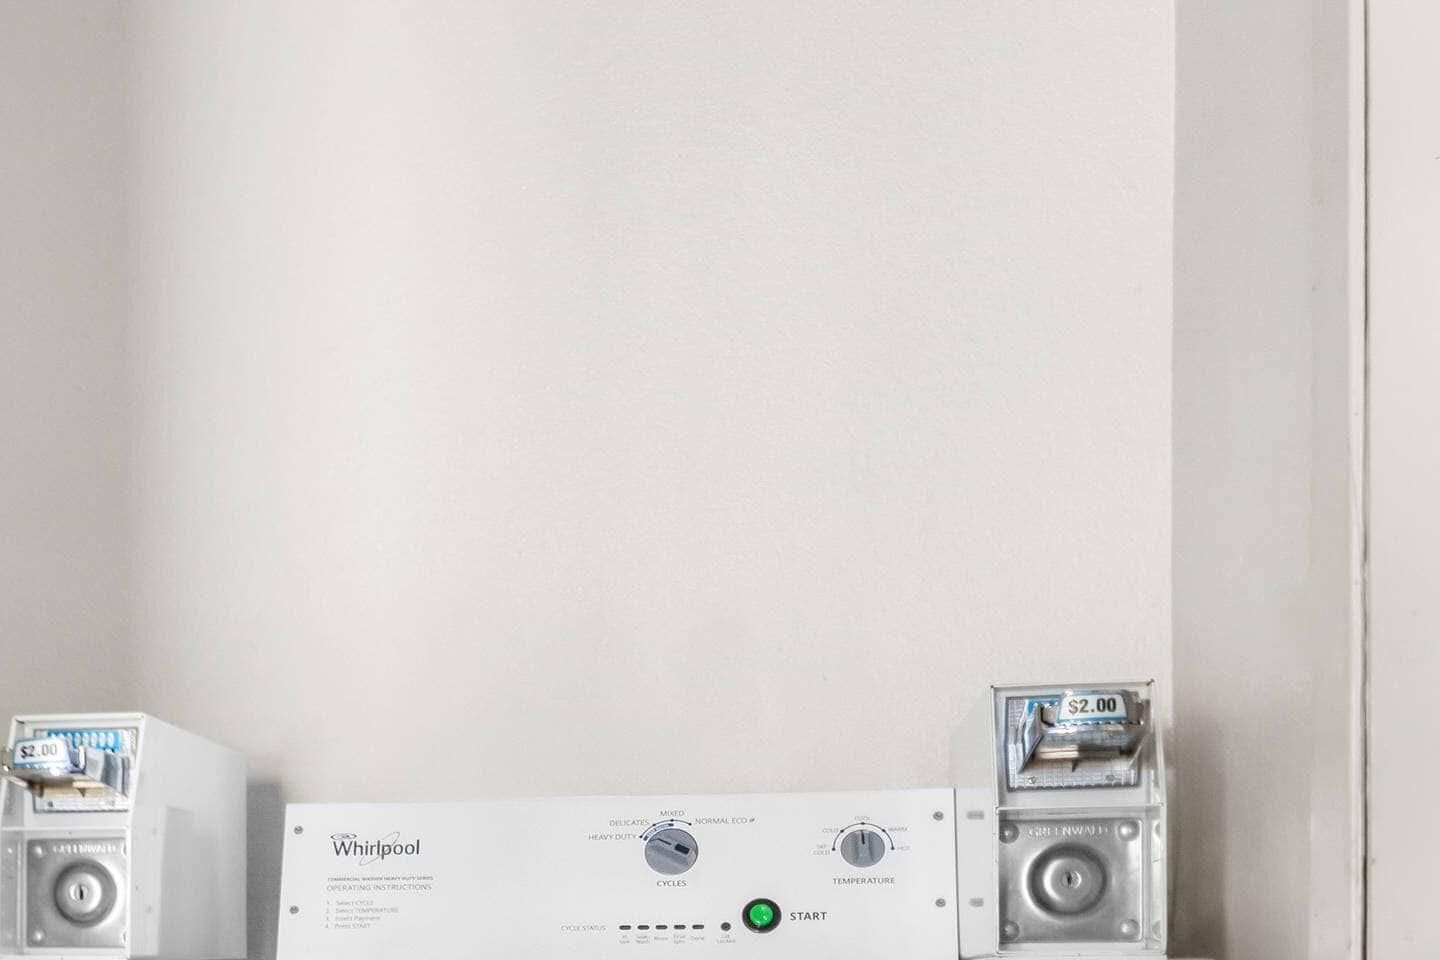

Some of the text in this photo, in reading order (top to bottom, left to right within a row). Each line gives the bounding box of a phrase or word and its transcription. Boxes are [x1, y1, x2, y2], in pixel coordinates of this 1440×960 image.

[1068, 697, 1116, 715] $2.00
[20, 743, 58, 759] $2.00
[609, 819, 649, 827] DELICATES
[332, 839, 420, 860] Whirlpool
[832, 877, 896, 885] TEMPERATURE
[326, 883, 432, 892] OPERATING INSTRUCTIONS
[790, 911, 828, 921] START
